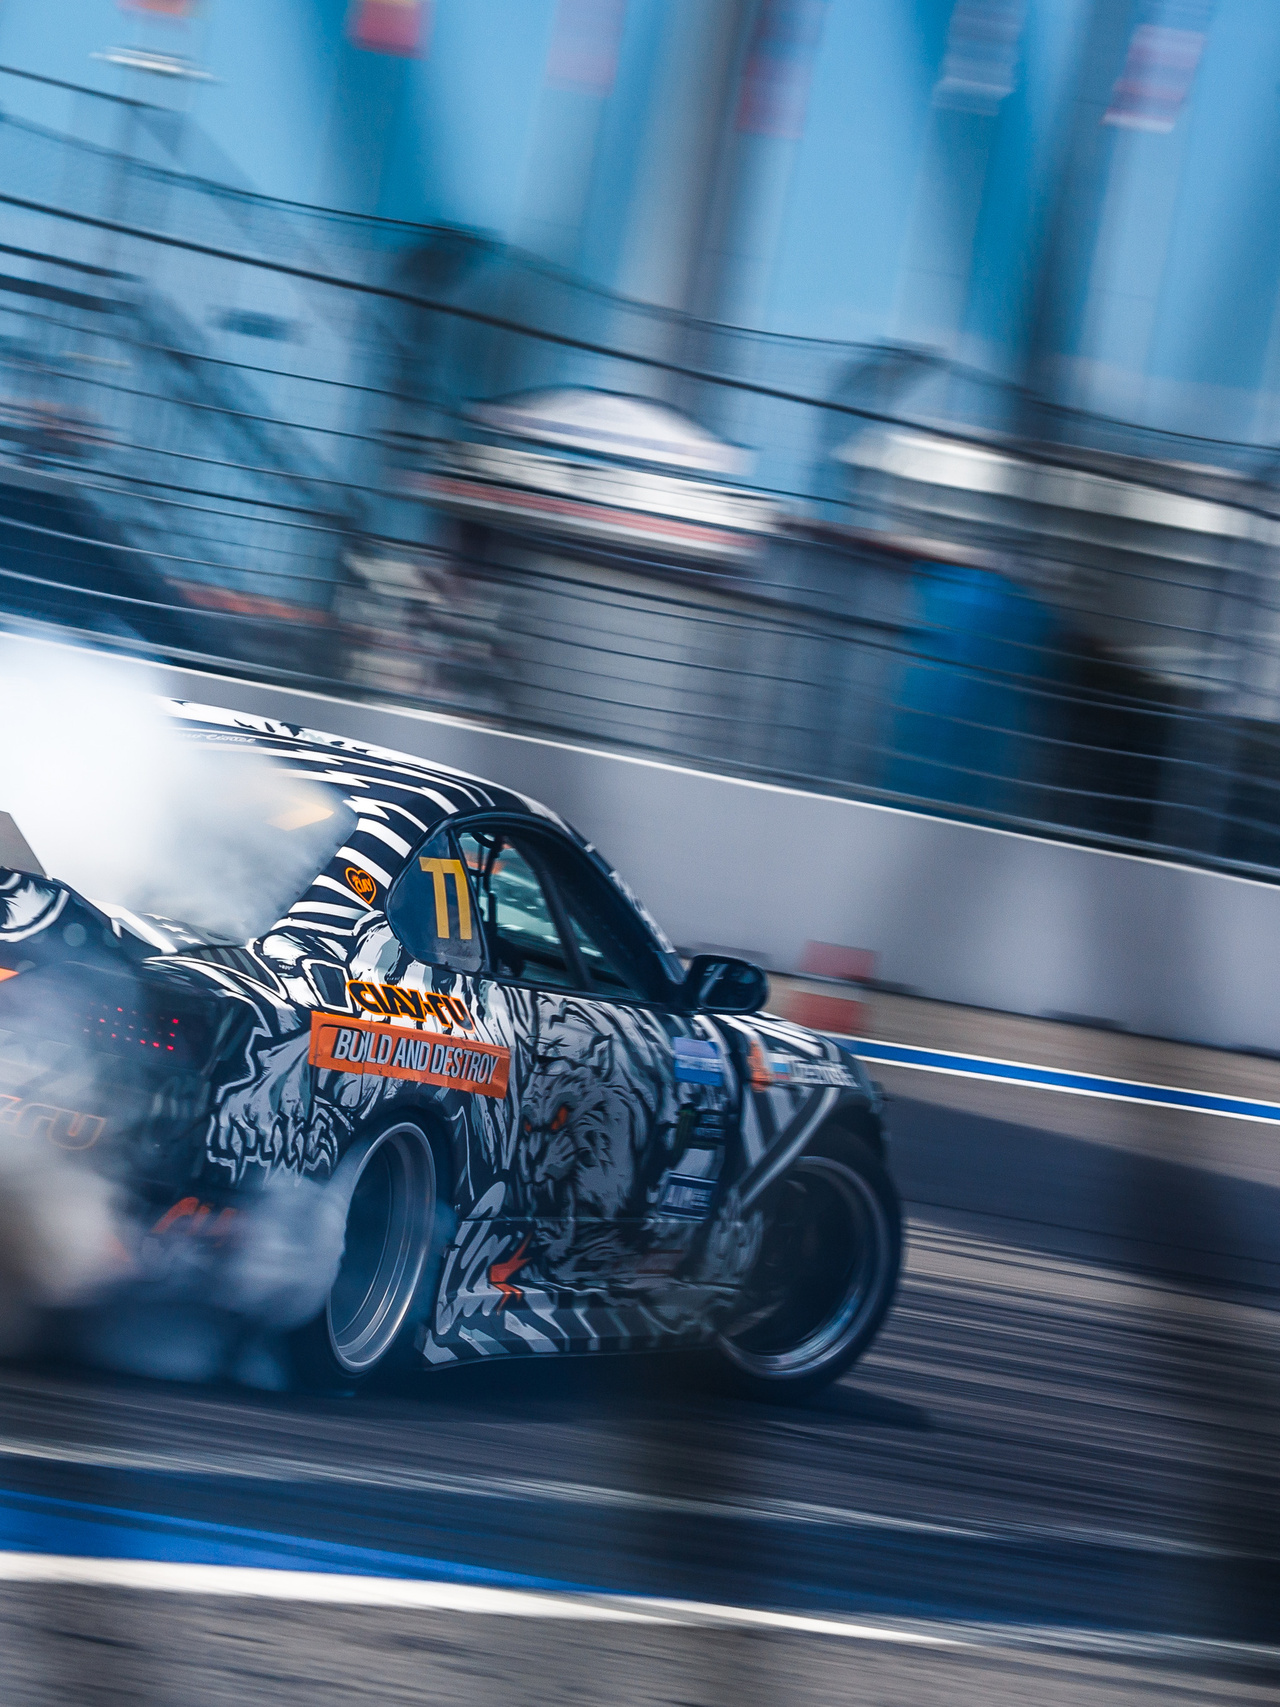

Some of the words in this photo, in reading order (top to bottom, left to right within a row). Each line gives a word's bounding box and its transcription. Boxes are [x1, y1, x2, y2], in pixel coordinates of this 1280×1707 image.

[332, 1029, 392, 1065] BUILD
[391, 1038, 430, 1071] AND
[431, 1044, 499, 1084] DESTROY
